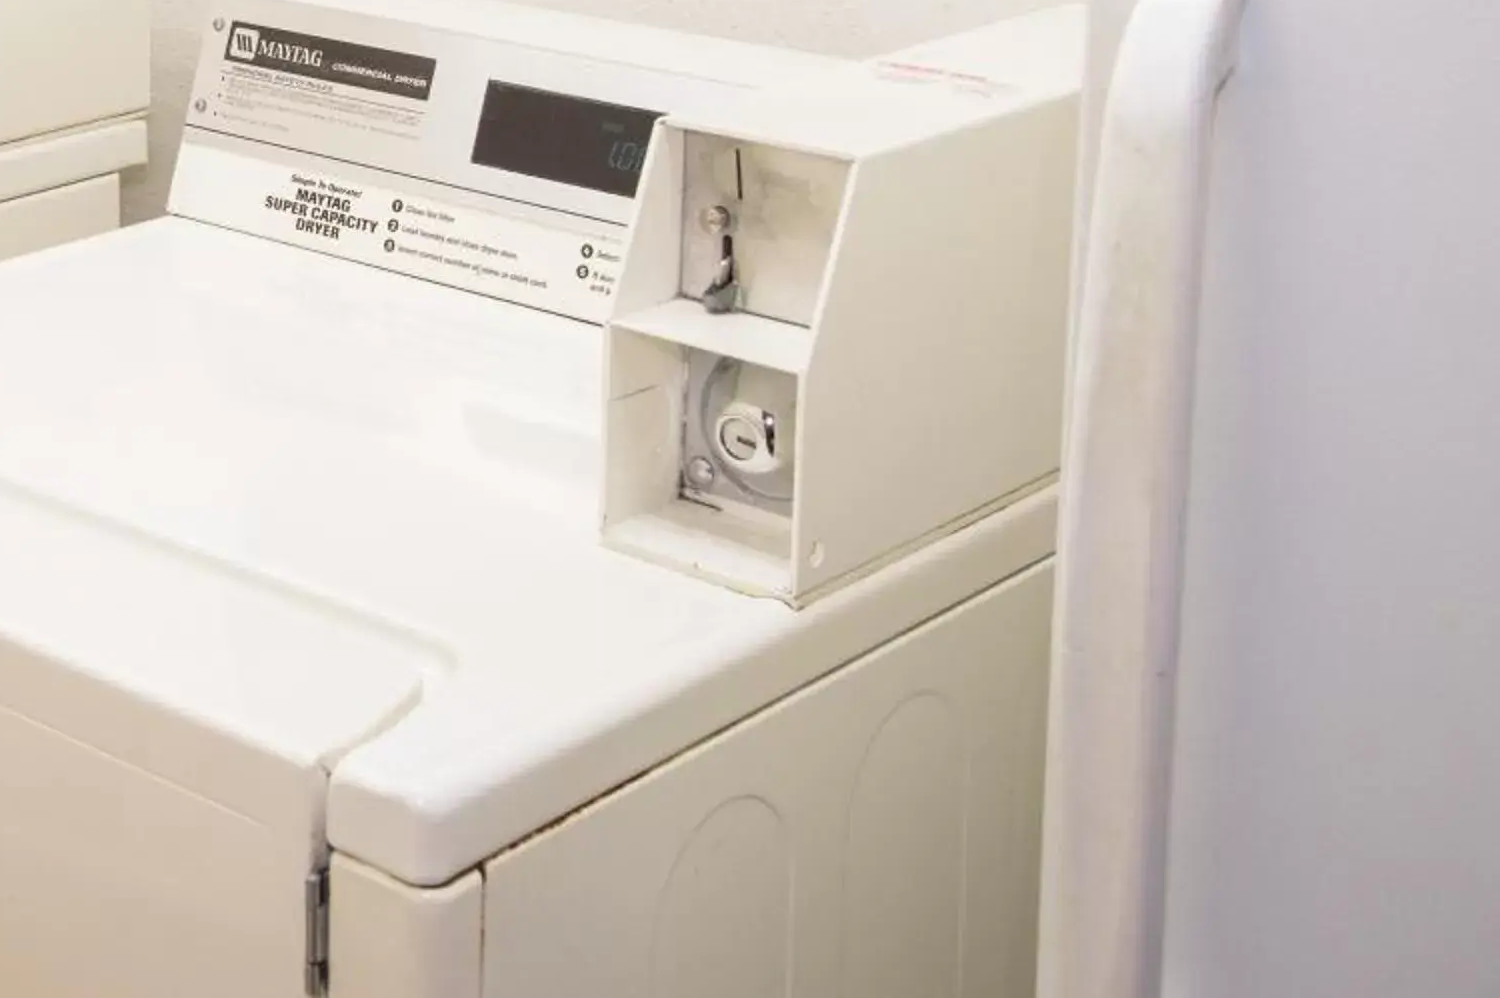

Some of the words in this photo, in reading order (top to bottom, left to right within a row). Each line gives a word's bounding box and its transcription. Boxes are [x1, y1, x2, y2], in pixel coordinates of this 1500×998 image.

[258, 38, 324, 68] MAYTAG
[331, 62, 393, 81] COMMERCIAL
[393, 74, 427, 88] DRYER
[265, 195, 309, 217] SUPER
[311, 207, 379, 233] CAPACITY
[296, 188, 351, 212] MAYTAG
[295, 217, 341, 240] DRYER
